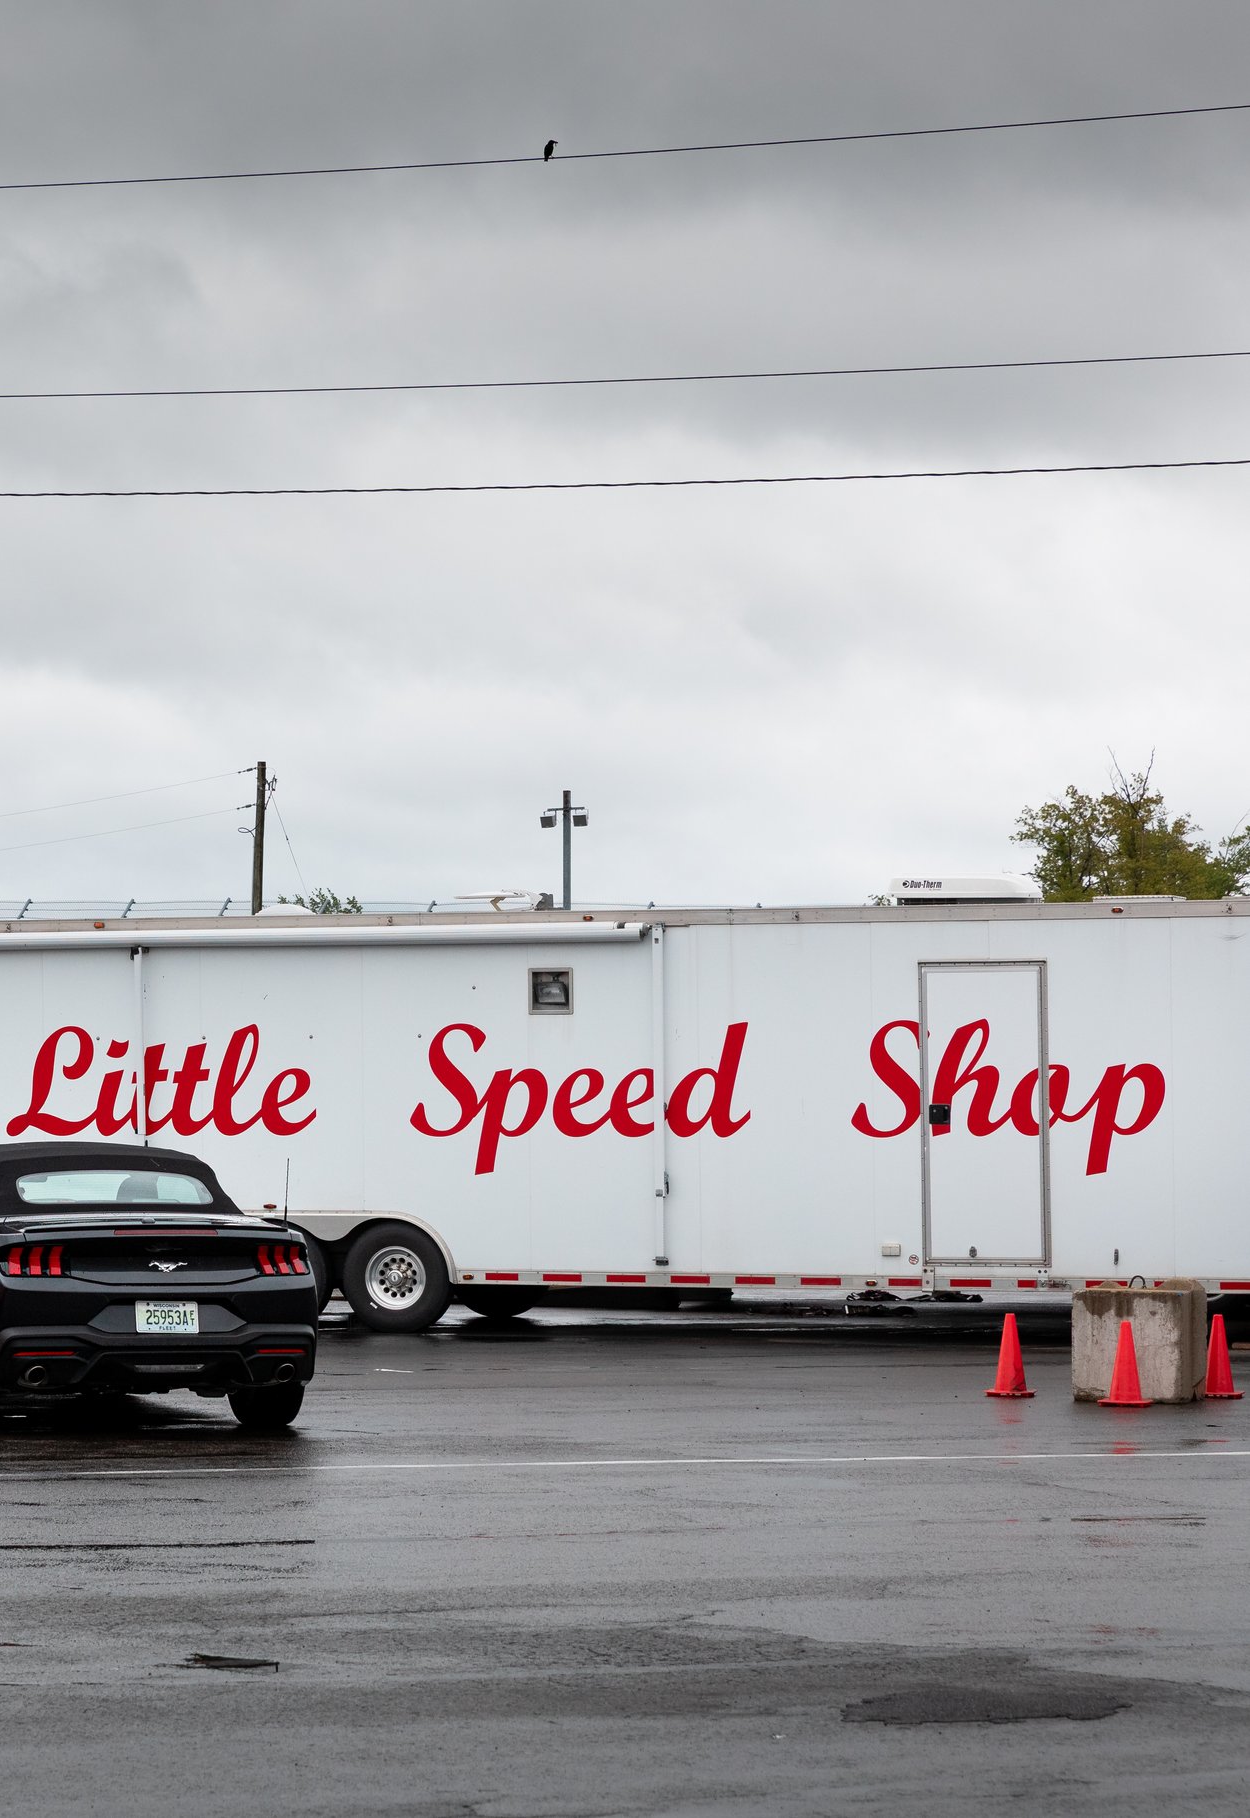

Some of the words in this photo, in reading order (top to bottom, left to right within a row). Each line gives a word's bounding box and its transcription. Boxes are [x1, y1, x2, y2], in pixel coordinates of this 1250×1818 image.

[909, 880, 943, 889] Duo-Therm
[6, 1023, 317, 1137] Little
[406, 1022, 752, 1175] Speed
[851, 1018, 1166, 1176] Shop
[145, 1309, 189, 1326] 25953A
